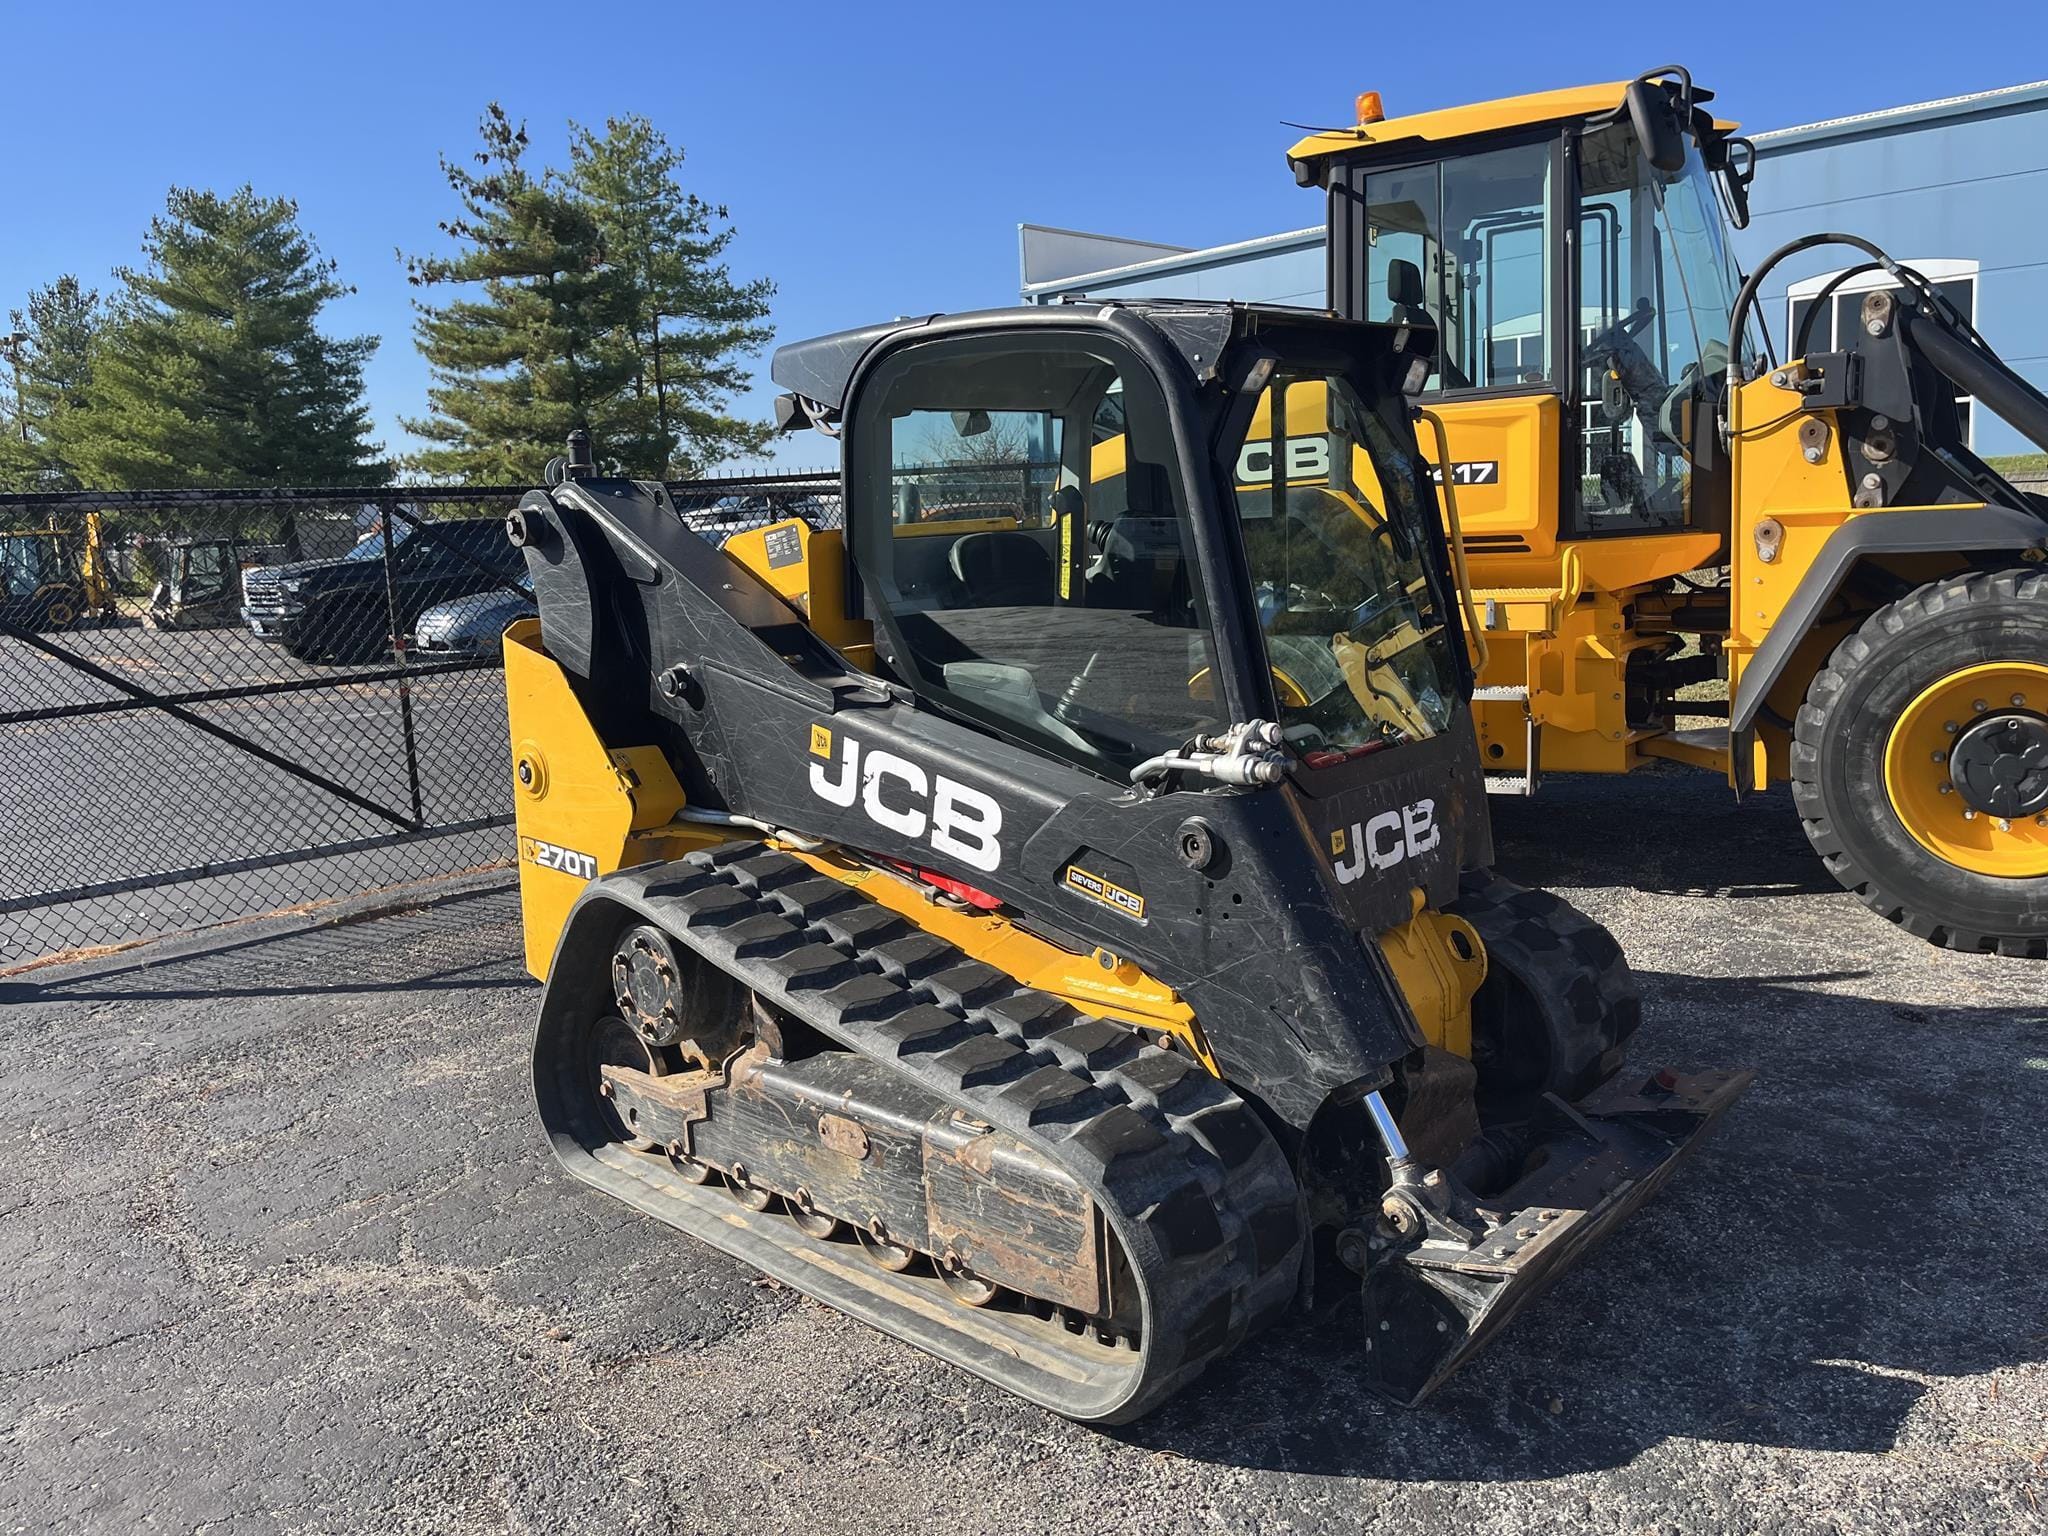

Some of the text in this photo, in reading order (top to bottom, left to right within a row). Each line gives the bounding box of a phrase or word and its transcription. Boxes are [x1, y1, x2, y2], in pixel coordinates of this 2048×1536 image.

[1237, 437, 1329, 482] CB
[810, 736, 1003, 872] JCB
[1334, 799, 1440, 884] JCB
[1071, 872, 1140, 912] SIEVERS JCB
